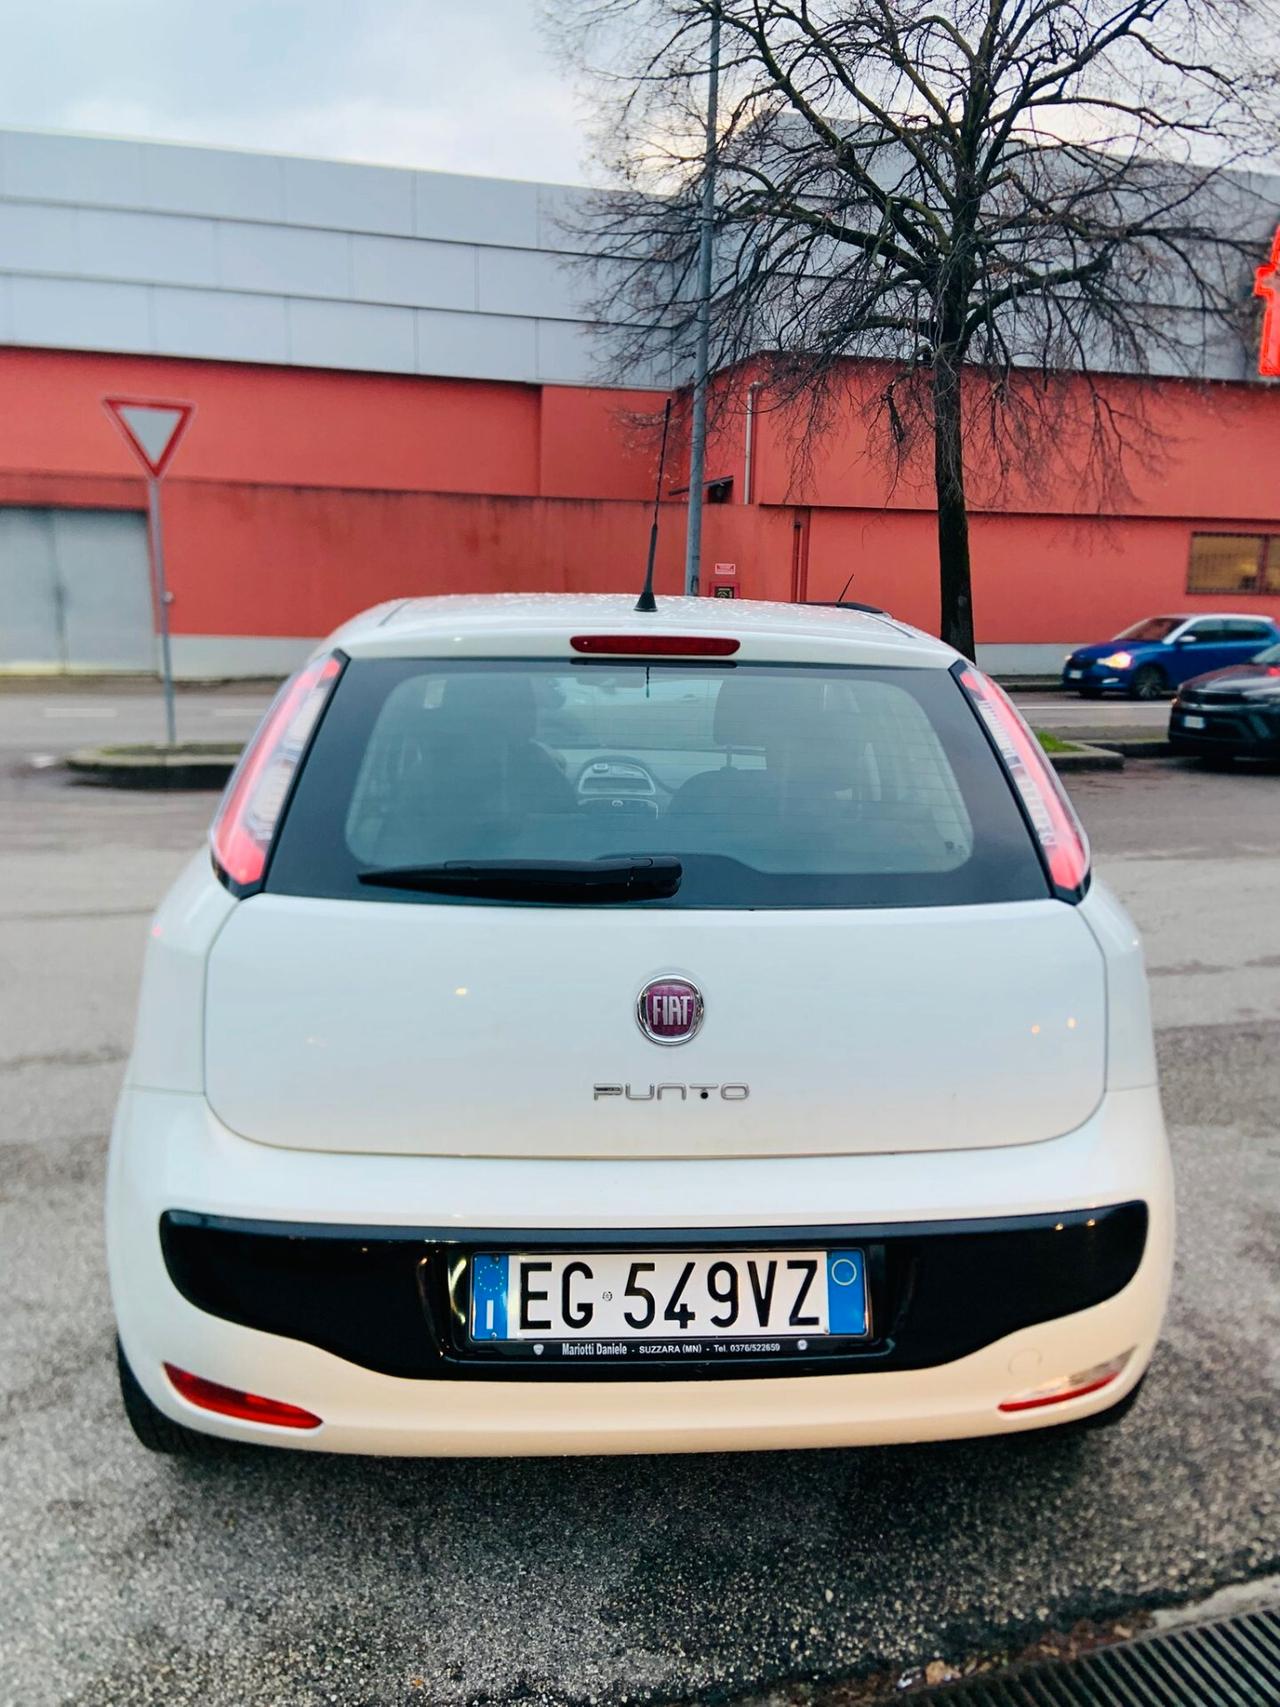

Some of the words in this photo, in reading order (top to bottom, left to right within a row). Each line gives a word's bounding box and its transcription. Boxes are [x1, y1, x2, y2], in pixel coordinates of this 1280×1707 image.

[653, 995, 690, 1026] FIAT
[593, 1082, 750, 1101] PUNTO
[519, 1261, 594, 1329] EG
[623, 1257, 820, 1329] 549VZ
[562, 1342, 594, 1356] Mariotti
[596, 1342, 627, 1356] Daniele
[639, 1345, 680, 1354] SUZZARA
[682, 1344, 702, 1354] (MN)
